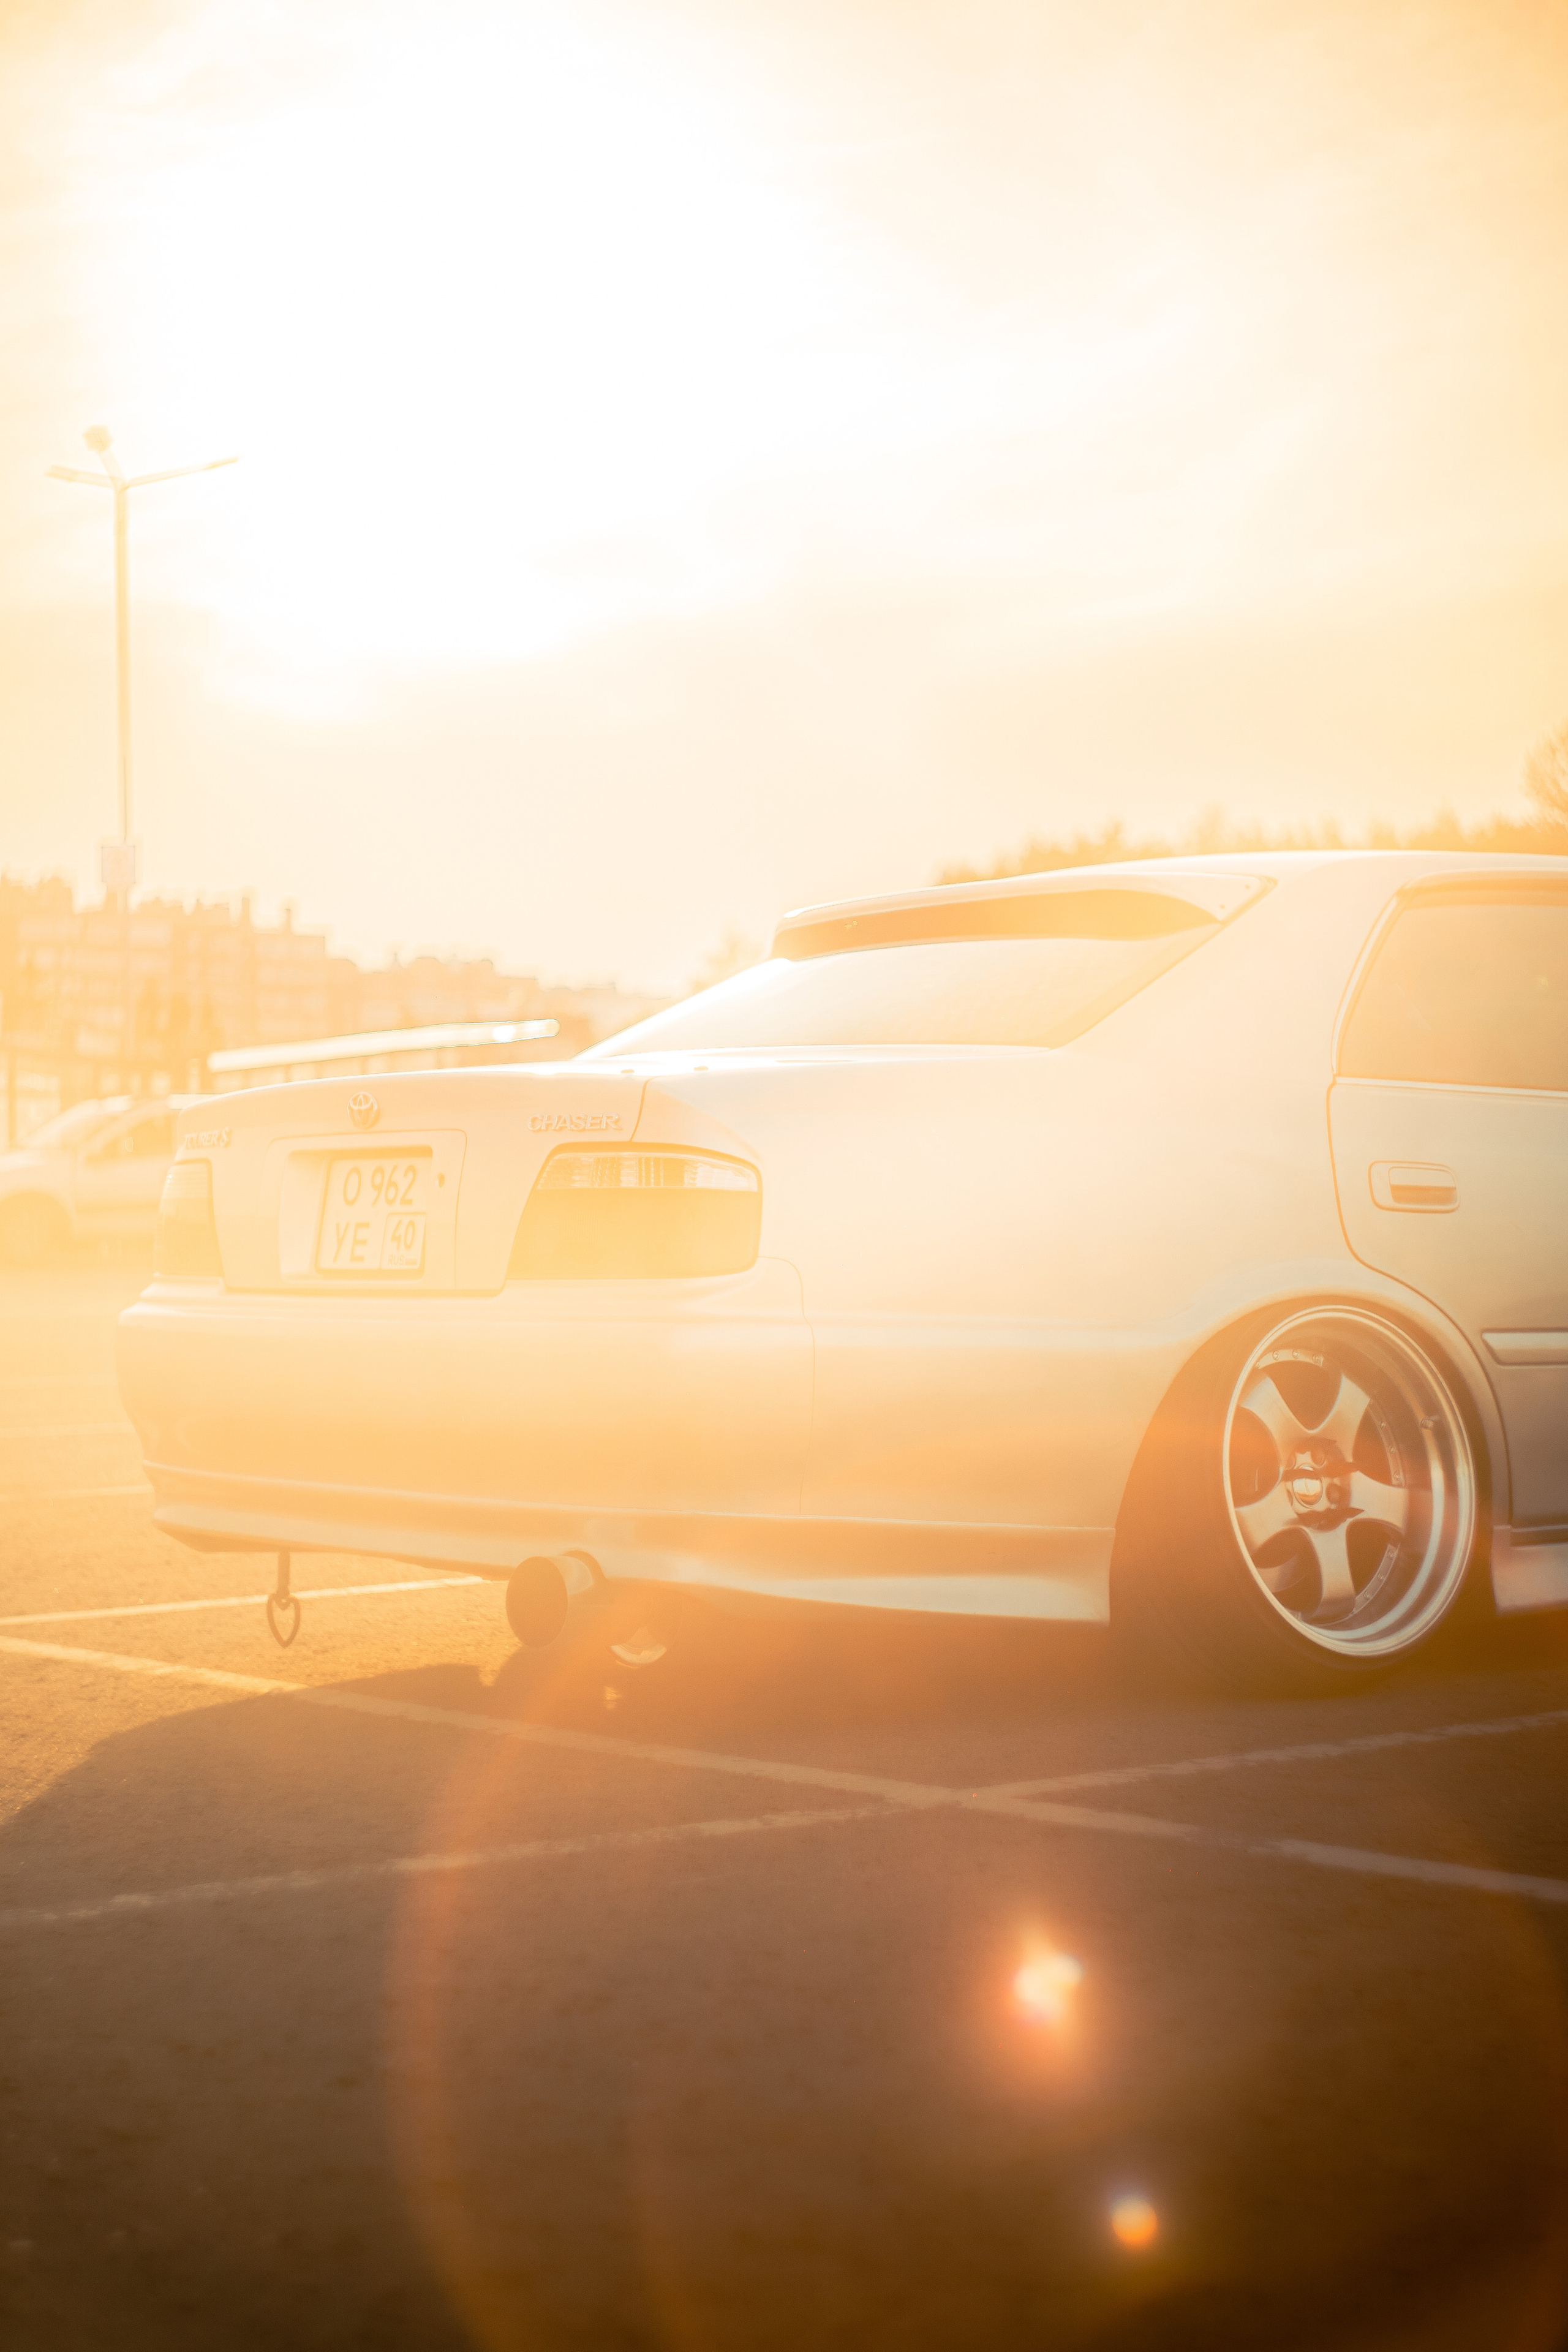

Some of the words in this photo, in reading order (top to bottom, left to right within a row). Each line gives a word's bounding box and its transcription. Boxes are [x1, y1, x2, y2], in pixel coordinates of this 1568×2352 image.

[527, 1112, 622, 1132] CHASER
[371, 1164, 417, 1207] 962
[390, 1219, 415, 1251] 40
[387, 1254, 405, 1266] RUS
